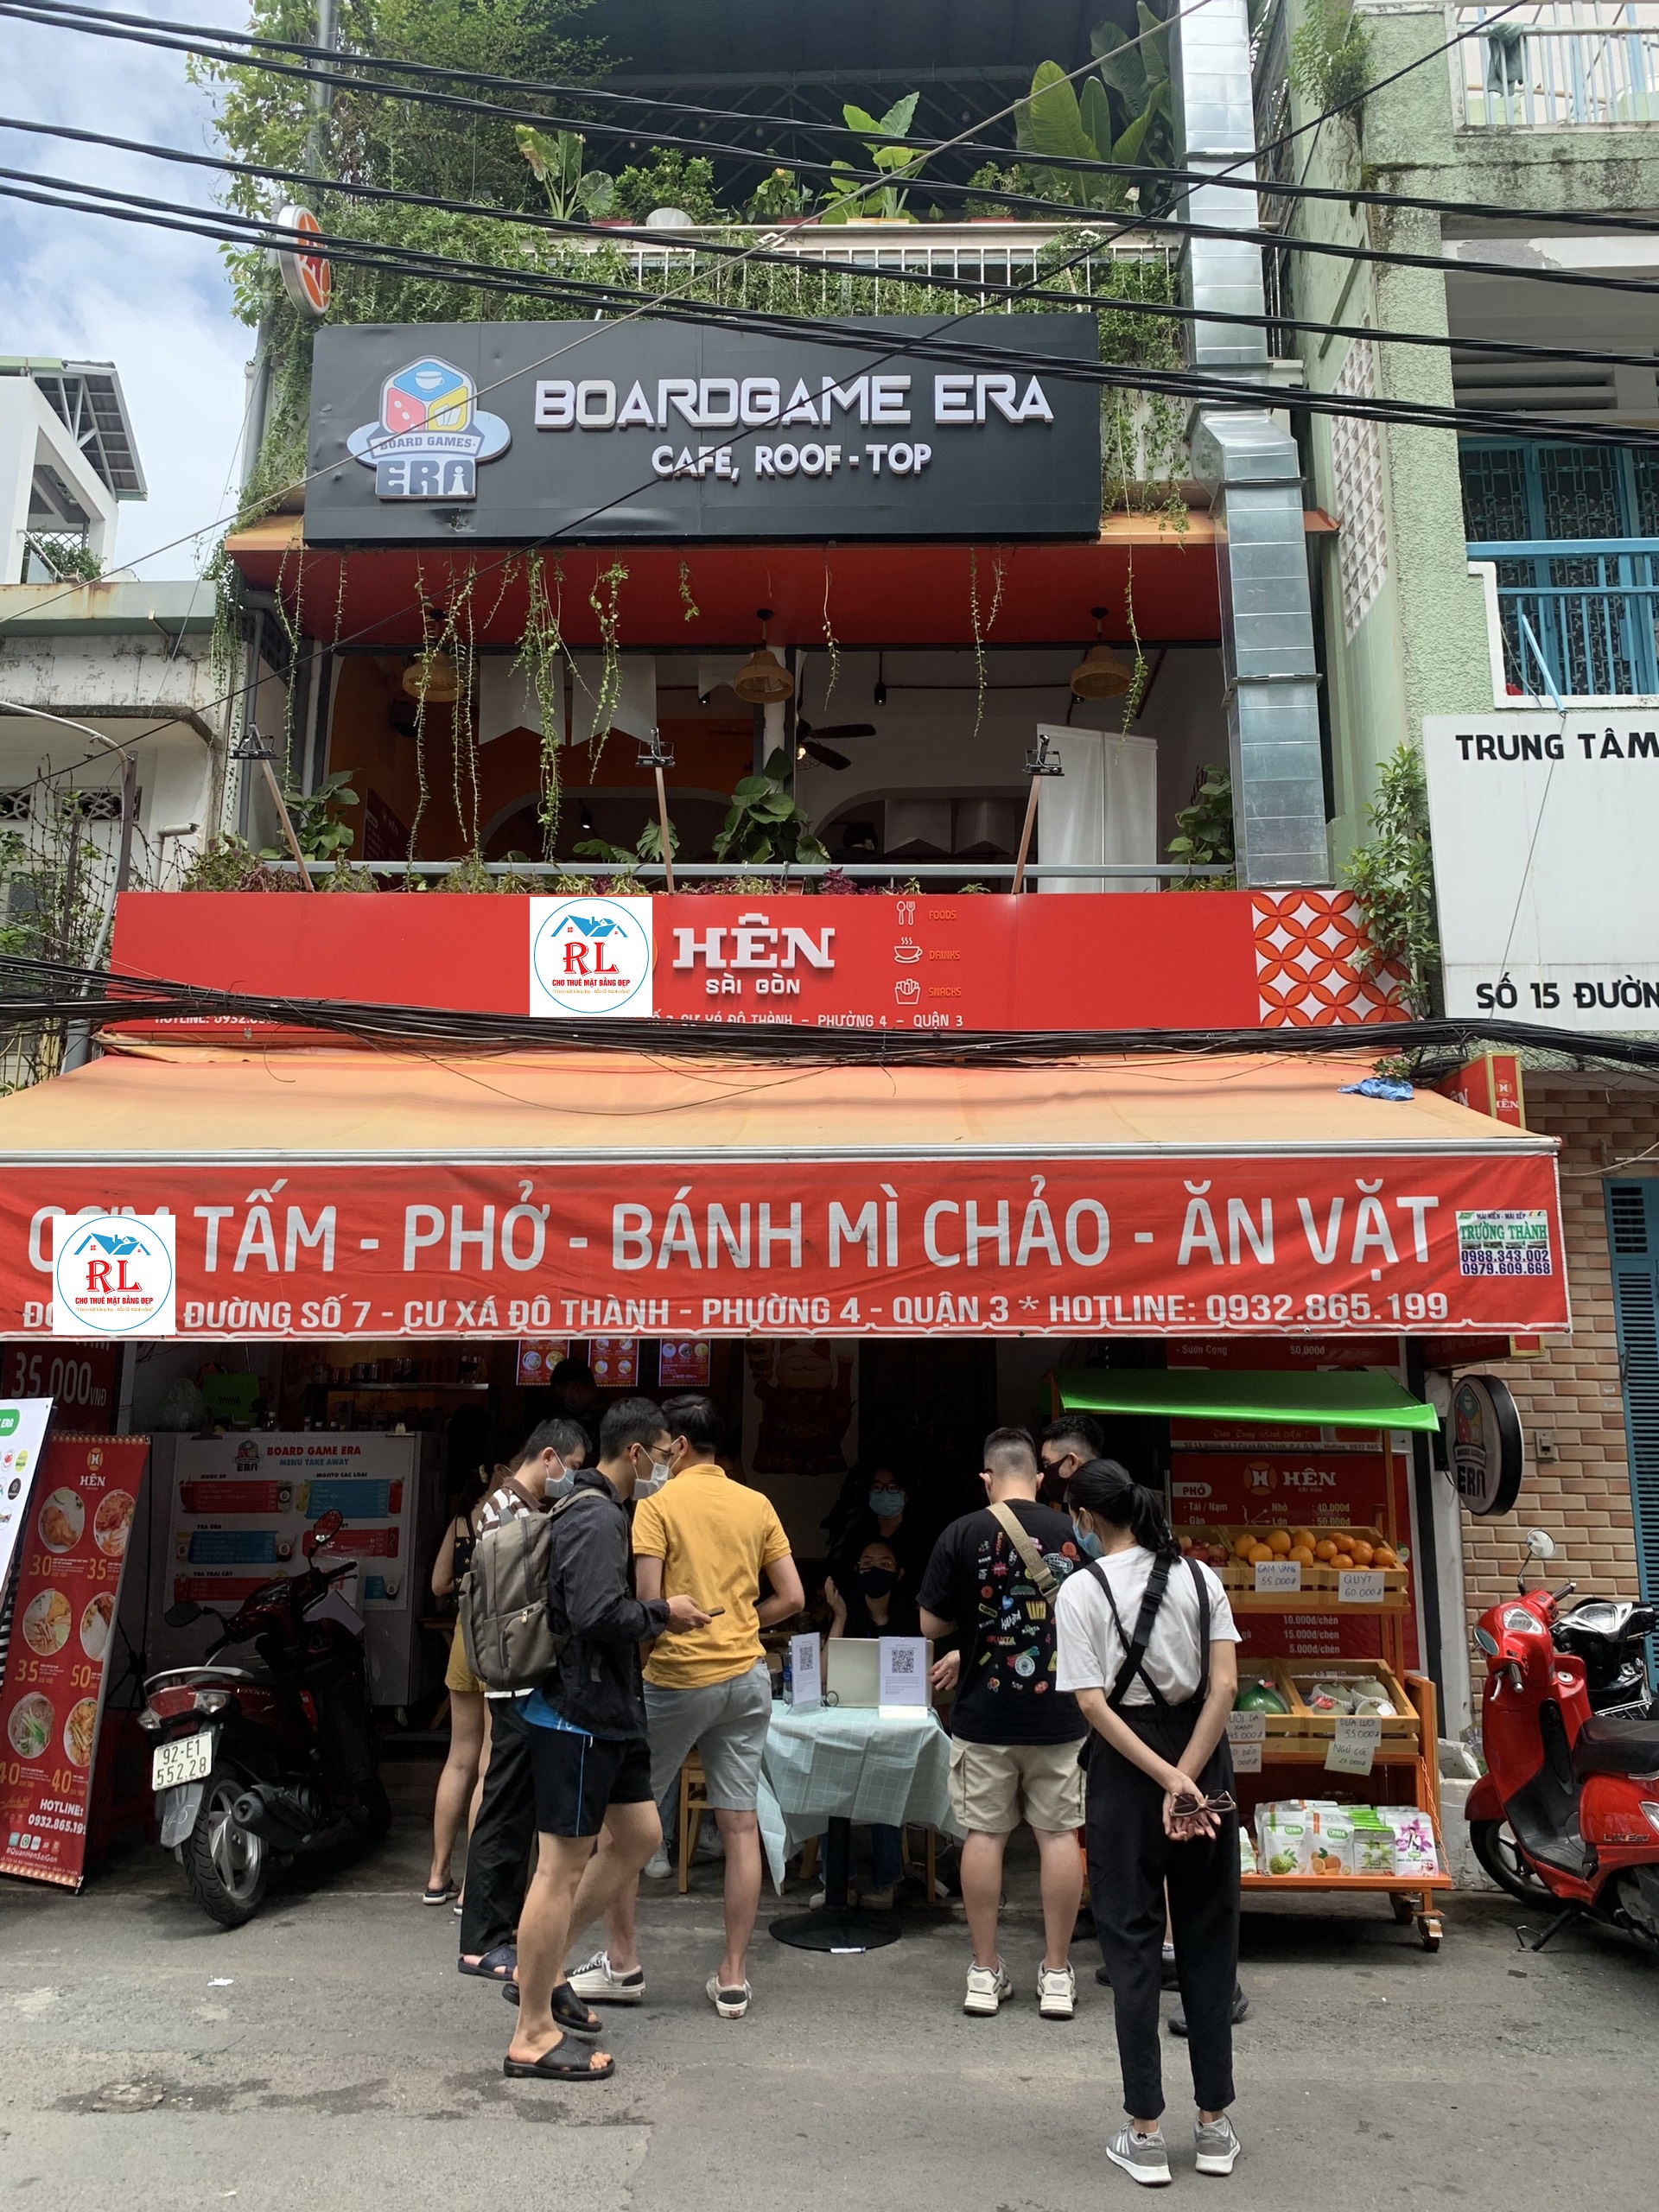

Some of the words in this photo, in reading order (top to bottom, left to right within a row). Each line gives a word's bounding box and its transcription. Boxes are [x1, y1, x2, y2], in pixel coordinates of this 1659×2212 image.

[535, 375, 912, 429] BOARDGAME
[935, 375, 1055, 424] ERA
[380, 436, 423, 450] BOARD
[427, 436, 472, 448] GAMES
[652, 445, 740, 483] CAFE,
[755, 443, 842, 475] ROOF
[866, 442, 931, 474] TOP
[377, 460, 474, 495] ERA
[1455, 734, 1565, 761] TRUNG
[1578, 728, 1659, 760] TÂM
[929, 910, 957, 920] FOODS
[672, 912, 836, 969] HÊN
[929, 950, 961, 961] DRINKS
[705, 973, 742, 995] SÀI
[755, 972, 800, 995] GÒN
[929, 987, 962, 997] SNACKS
[1477, 972, 1518, 1009] SỐ
[1529, 982, 1560, 1009] 15
[1573, 975, 1659, 1009] ĐƯỜN
[817, 1010, 874, 1027] PHƯỜNG
[879, 1014, 887, 1027] 4
[913, 1010, 950, 1029] QUẬN
[956, 1015, 963, 1027] 3
[194, 1179, 337, 1273] TẤM
[404, 1179, 550, 1272] PHỞ
[612, 1185, 803, 1271] BÁNH
[829, 1183, 899, 1268] MÌ
[923, 1174, 1111, 1268] CHẢO
[1177, 1179, 1275, 1266] ĂN
[1296, 1179, 1440, 1281] VẶT
[1459, 1221, 1504, 1241] TRƯỜNG
[1508, 1221, 1548, 1240] THÀNH
[1461, 1249, 1549, 1263] 0988.343.002
[1462, 1262, 1551, 1275] 0979.609.668
[183, 1296, 291, 1329] ĐƯỜNG
[301, 1293, 349, 1328] SỐ
[352, 1300, 372, 1328] 7
[404, 1300, 448, 1327] CƯ
[454, 1294, 497, 1327] XÁ
[507, 1294, 551, 1327] ĐÔ
[561, 1294, 670, 1325] THÀNH
[702, 1293, 830, 1325] PHƯỜNG
[840, 1297, 861, 1323] 4
[893, 1290, 978, 1329] QUẬN
[990, 1296, 1009, 1323] 3
[1050, 1295, 1196, 1323] HOTLINE:
[1206, 1292, 1448, 1322] 0932.865.199
[1289, 1345, 1325, 1355] 50.000đ
[267, 1446, 304, 1456] BOARD
[308, 1446, 337, 1455] GAME
[341, 1446, 361, 1455] ERA
[79, 1472, 105, 1486] HÊN
[1282, 1467, 1337, 1486] HÊN
[1457, 1465, 1486, 1499] ERA
[1183, 1483, 1205, 1495] PHỞ
[29, 1554, 52, 1576] 30
[87, 1557, 107, 1580] 35
[15, 1659, 39, 1682] 35
[70, 1664, 92, 1688] 50
[163, 1738, 200, 1764] 92-E1
[51, 1768, 73, 1794] 40
[157, 1757, 207, 1786] 552.28
[40, 1798, 84, 1816] HOTLINE:
